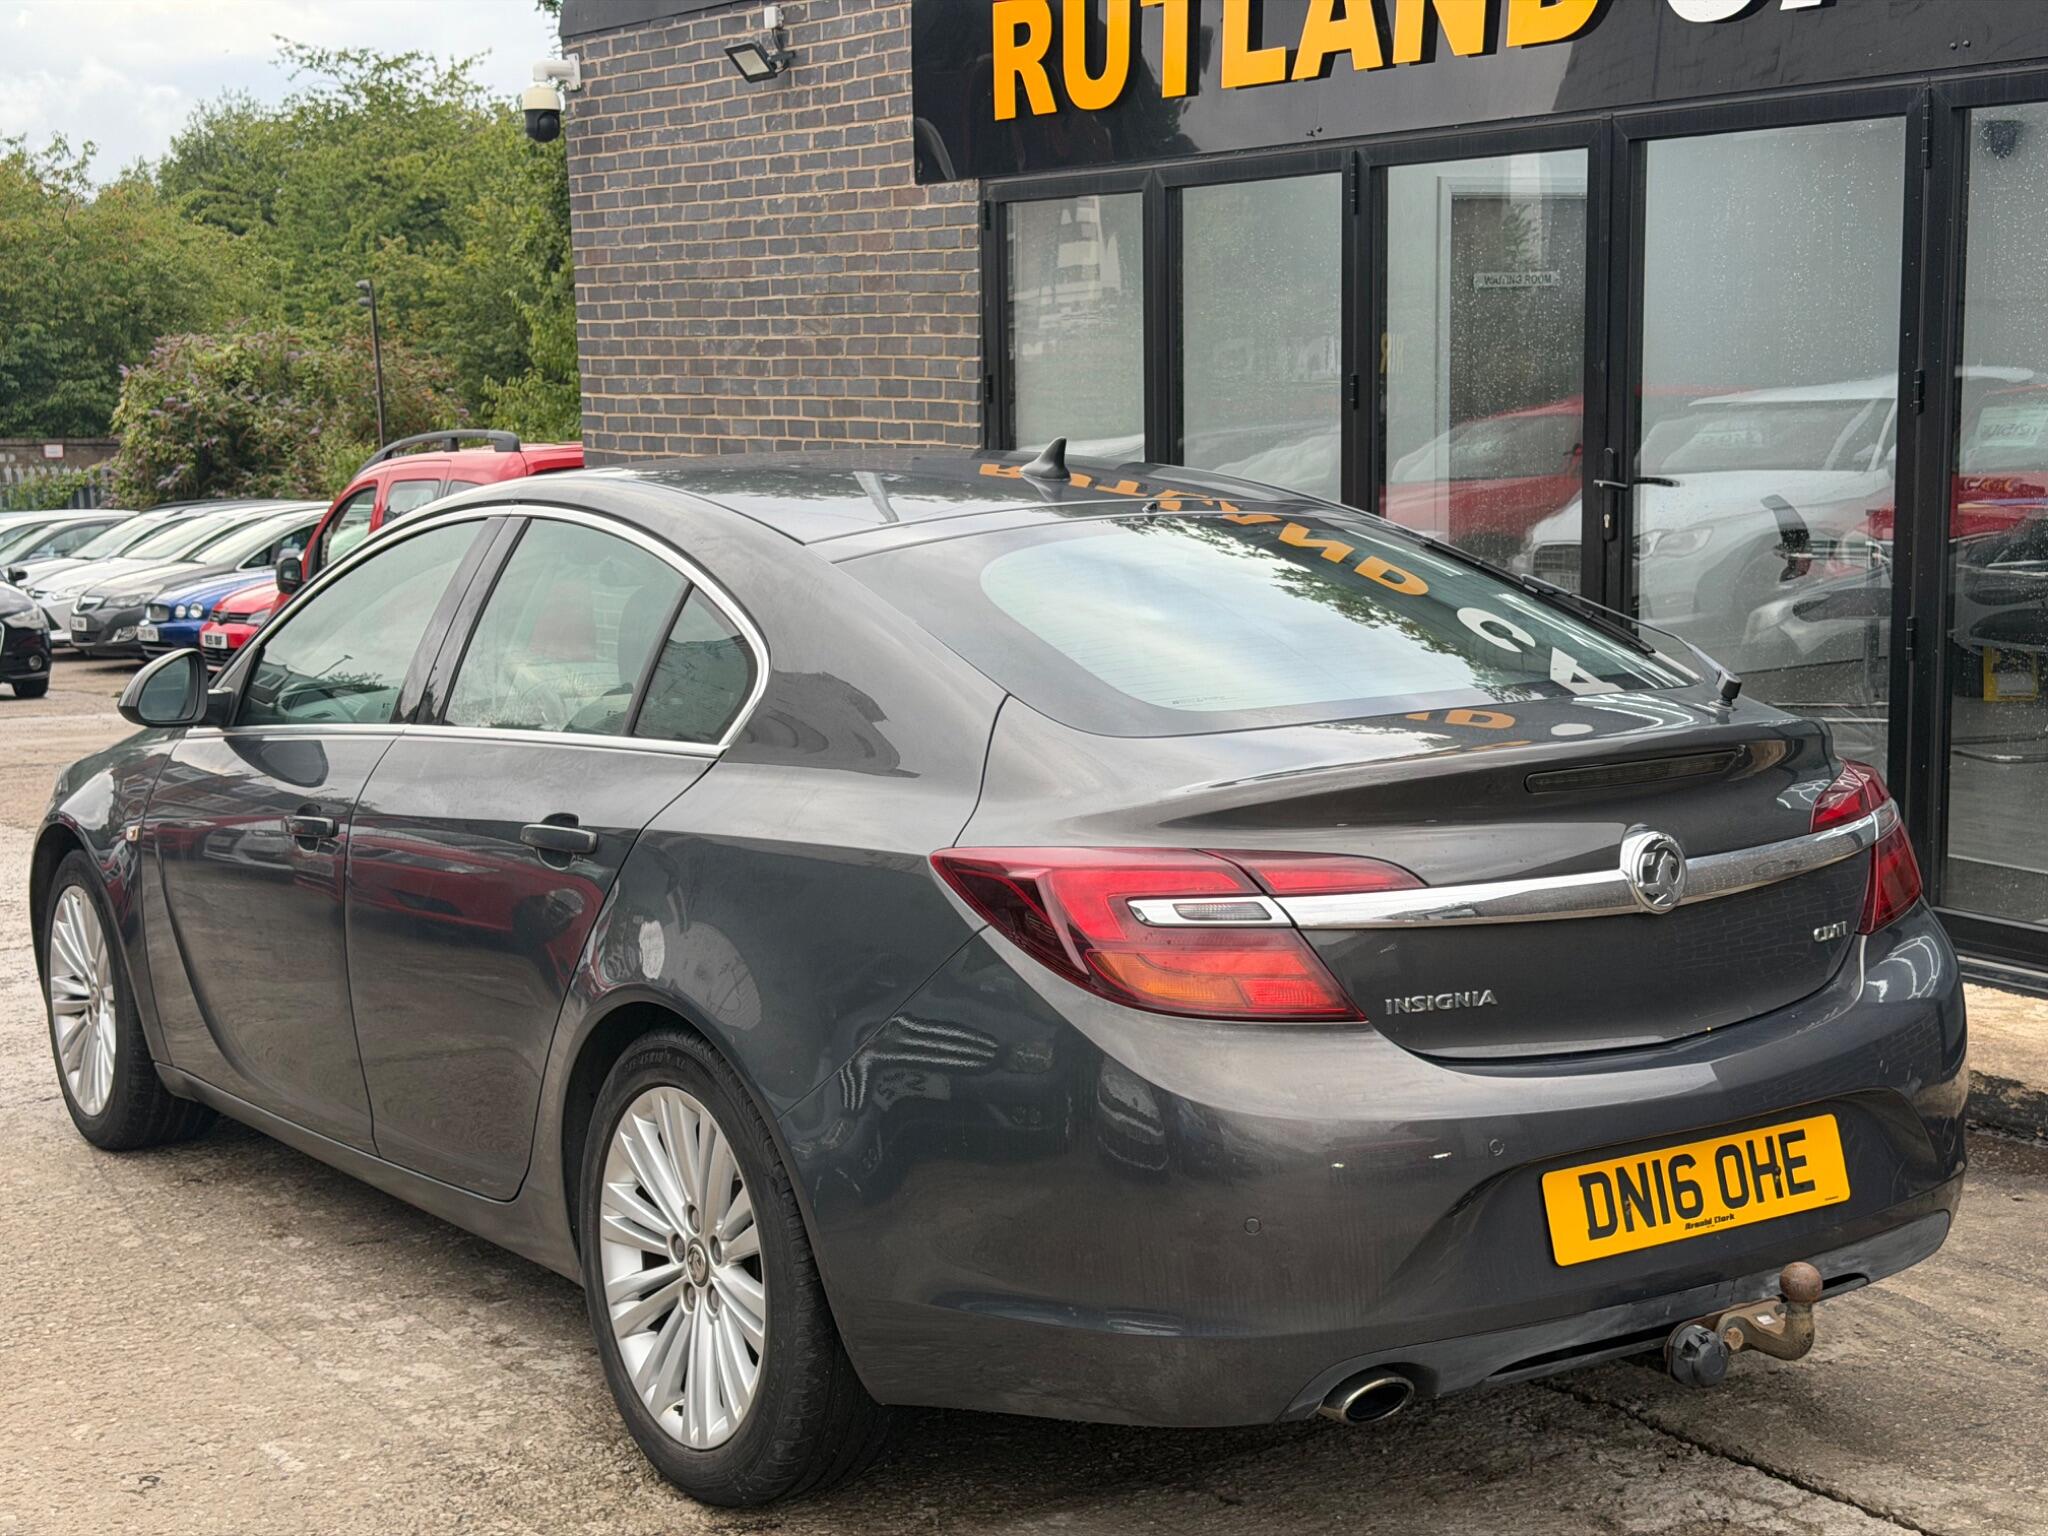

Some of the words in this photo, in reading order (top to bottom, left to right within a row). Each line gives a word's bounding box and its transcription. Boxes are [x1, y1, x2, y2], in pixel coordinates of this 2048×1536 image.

[1525, 273, 1552, 284] ROOM
[1384, 989, 1498, 1015] INSIGNIA
[1578, 1153, 1705, 1241] DN16
[1714, 1128, 1816, 1210] OHE
